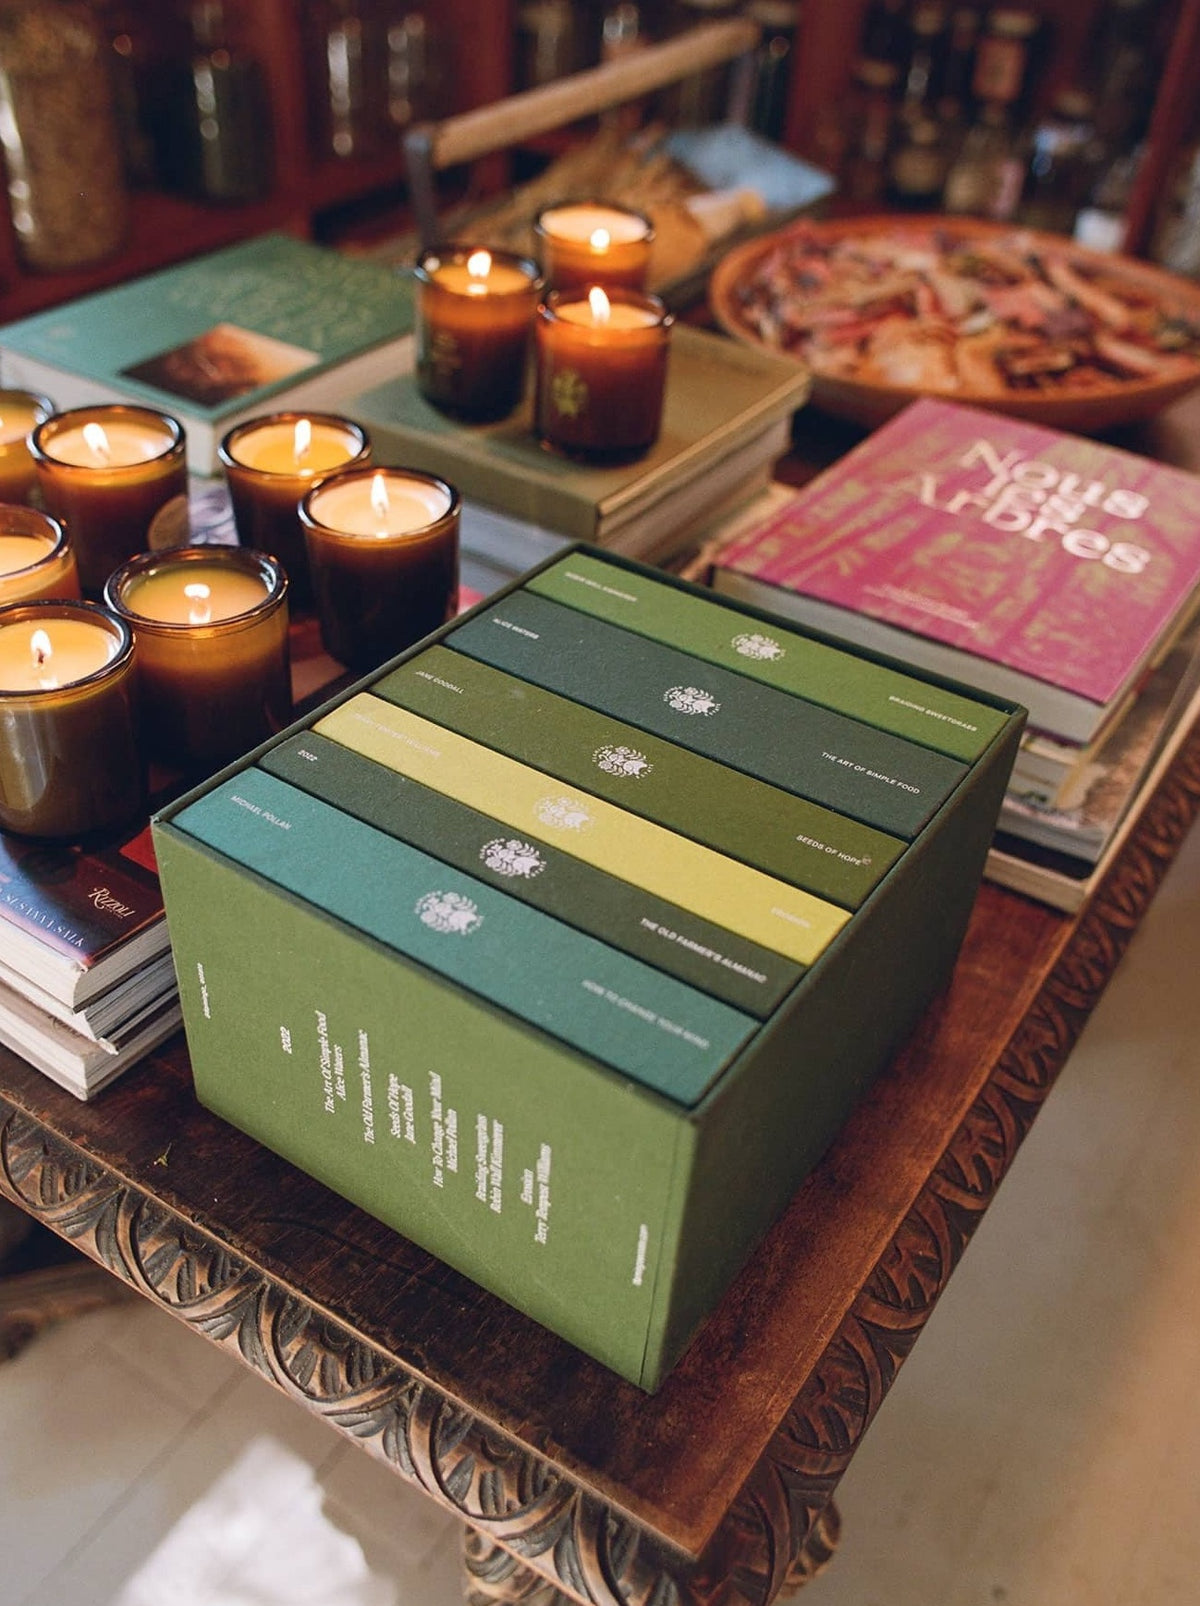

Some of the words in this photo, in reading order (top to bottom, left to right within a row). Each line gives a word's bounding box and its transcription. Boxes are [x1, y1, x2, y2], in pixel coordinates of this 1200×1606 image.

[821, 751, 837, 762] THE
[837, 758, 855, 768] ART
[854, 764, 867, 772] OF
[866, 769, 898, 785] SIMPLE
[896, 781, 921, 795] FOOD
[796, 834, 825, 850] SEEDS
[824, 846, 839, 855] OF
[641, 917, 659, 931] THE
[657, 926, 678, 940] OLD
[314, 1010, 328, 1037] Food
[280, 1026, 292, 1054] 2022
[358, 1029, 370, 1072] Almanac
[318, 1037, 332, 1068] Simple
[334, 1044, 344, 1076] Waters
[321, 1067, 332, 1080] Of
[324, 1080, 334, 1096] Art
[335, 1076, 346, 1101] Alice
[388, 1073, 400, 1100] Hope
[325, 1096, 335, 1113] The
[388, 1096, 399, 1112] Of
[401, 1084, 414, 1122] Goodall
[362, 1109, 374, 1127] Old
[389, 1112, 400, 1138] Seeds
[364, 1127, 374, 1144] The
[404, 1122, 416, 1144] Jane
[431, 1122, 444, 1156] Change
[432, 1155, 443, 1167] To
[432, 1167, 443, 1188] How
